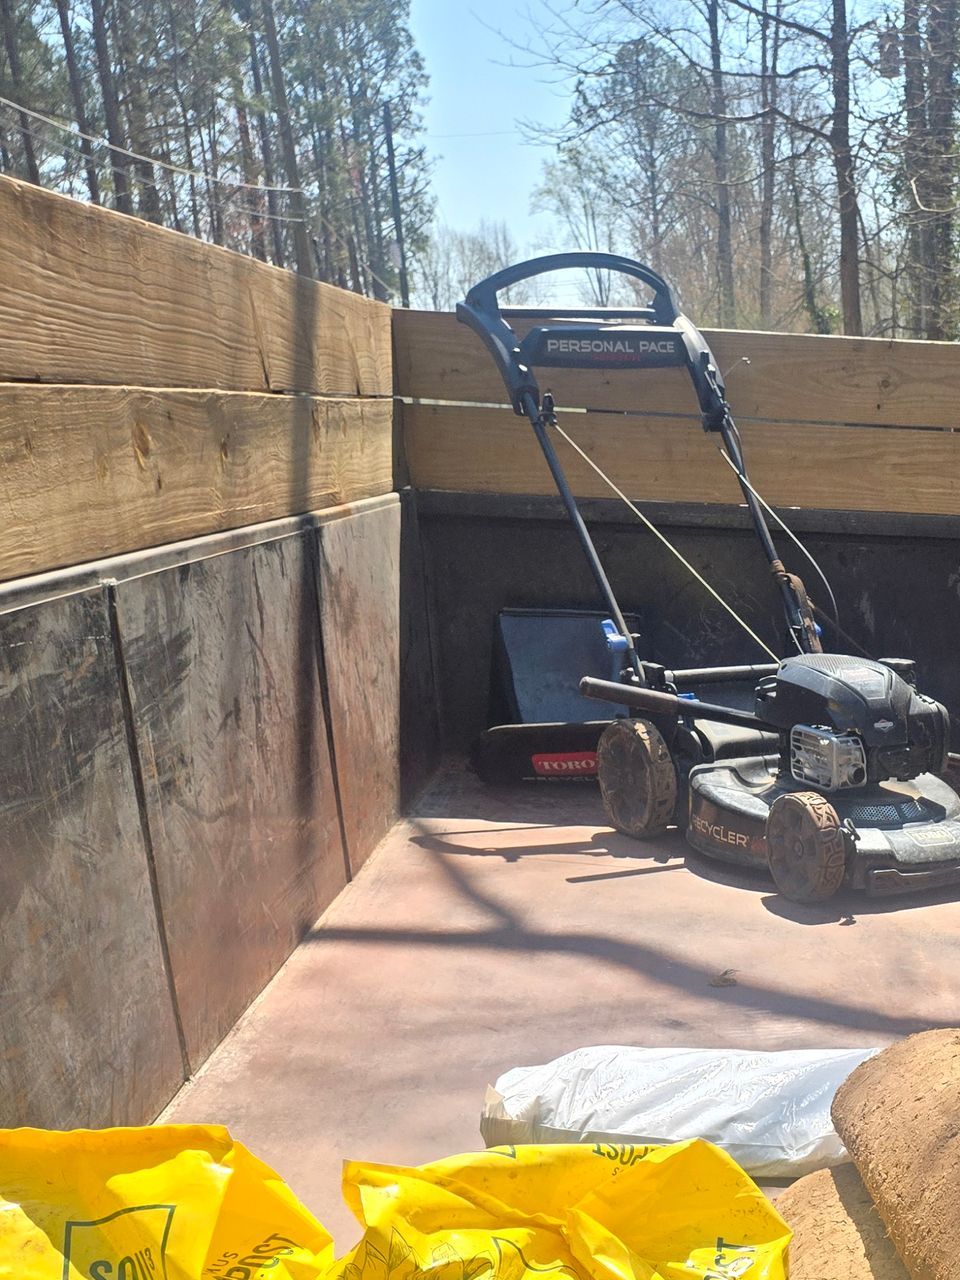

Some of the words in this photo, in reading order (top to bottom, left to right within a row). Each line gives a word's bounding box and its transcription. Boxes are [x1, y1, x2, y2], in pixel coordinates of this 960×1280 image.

[547, 340, 634, 353] PERSONAL
[640, 341, 675, 353] PACE
[539, 760, 596, 771] TORO
